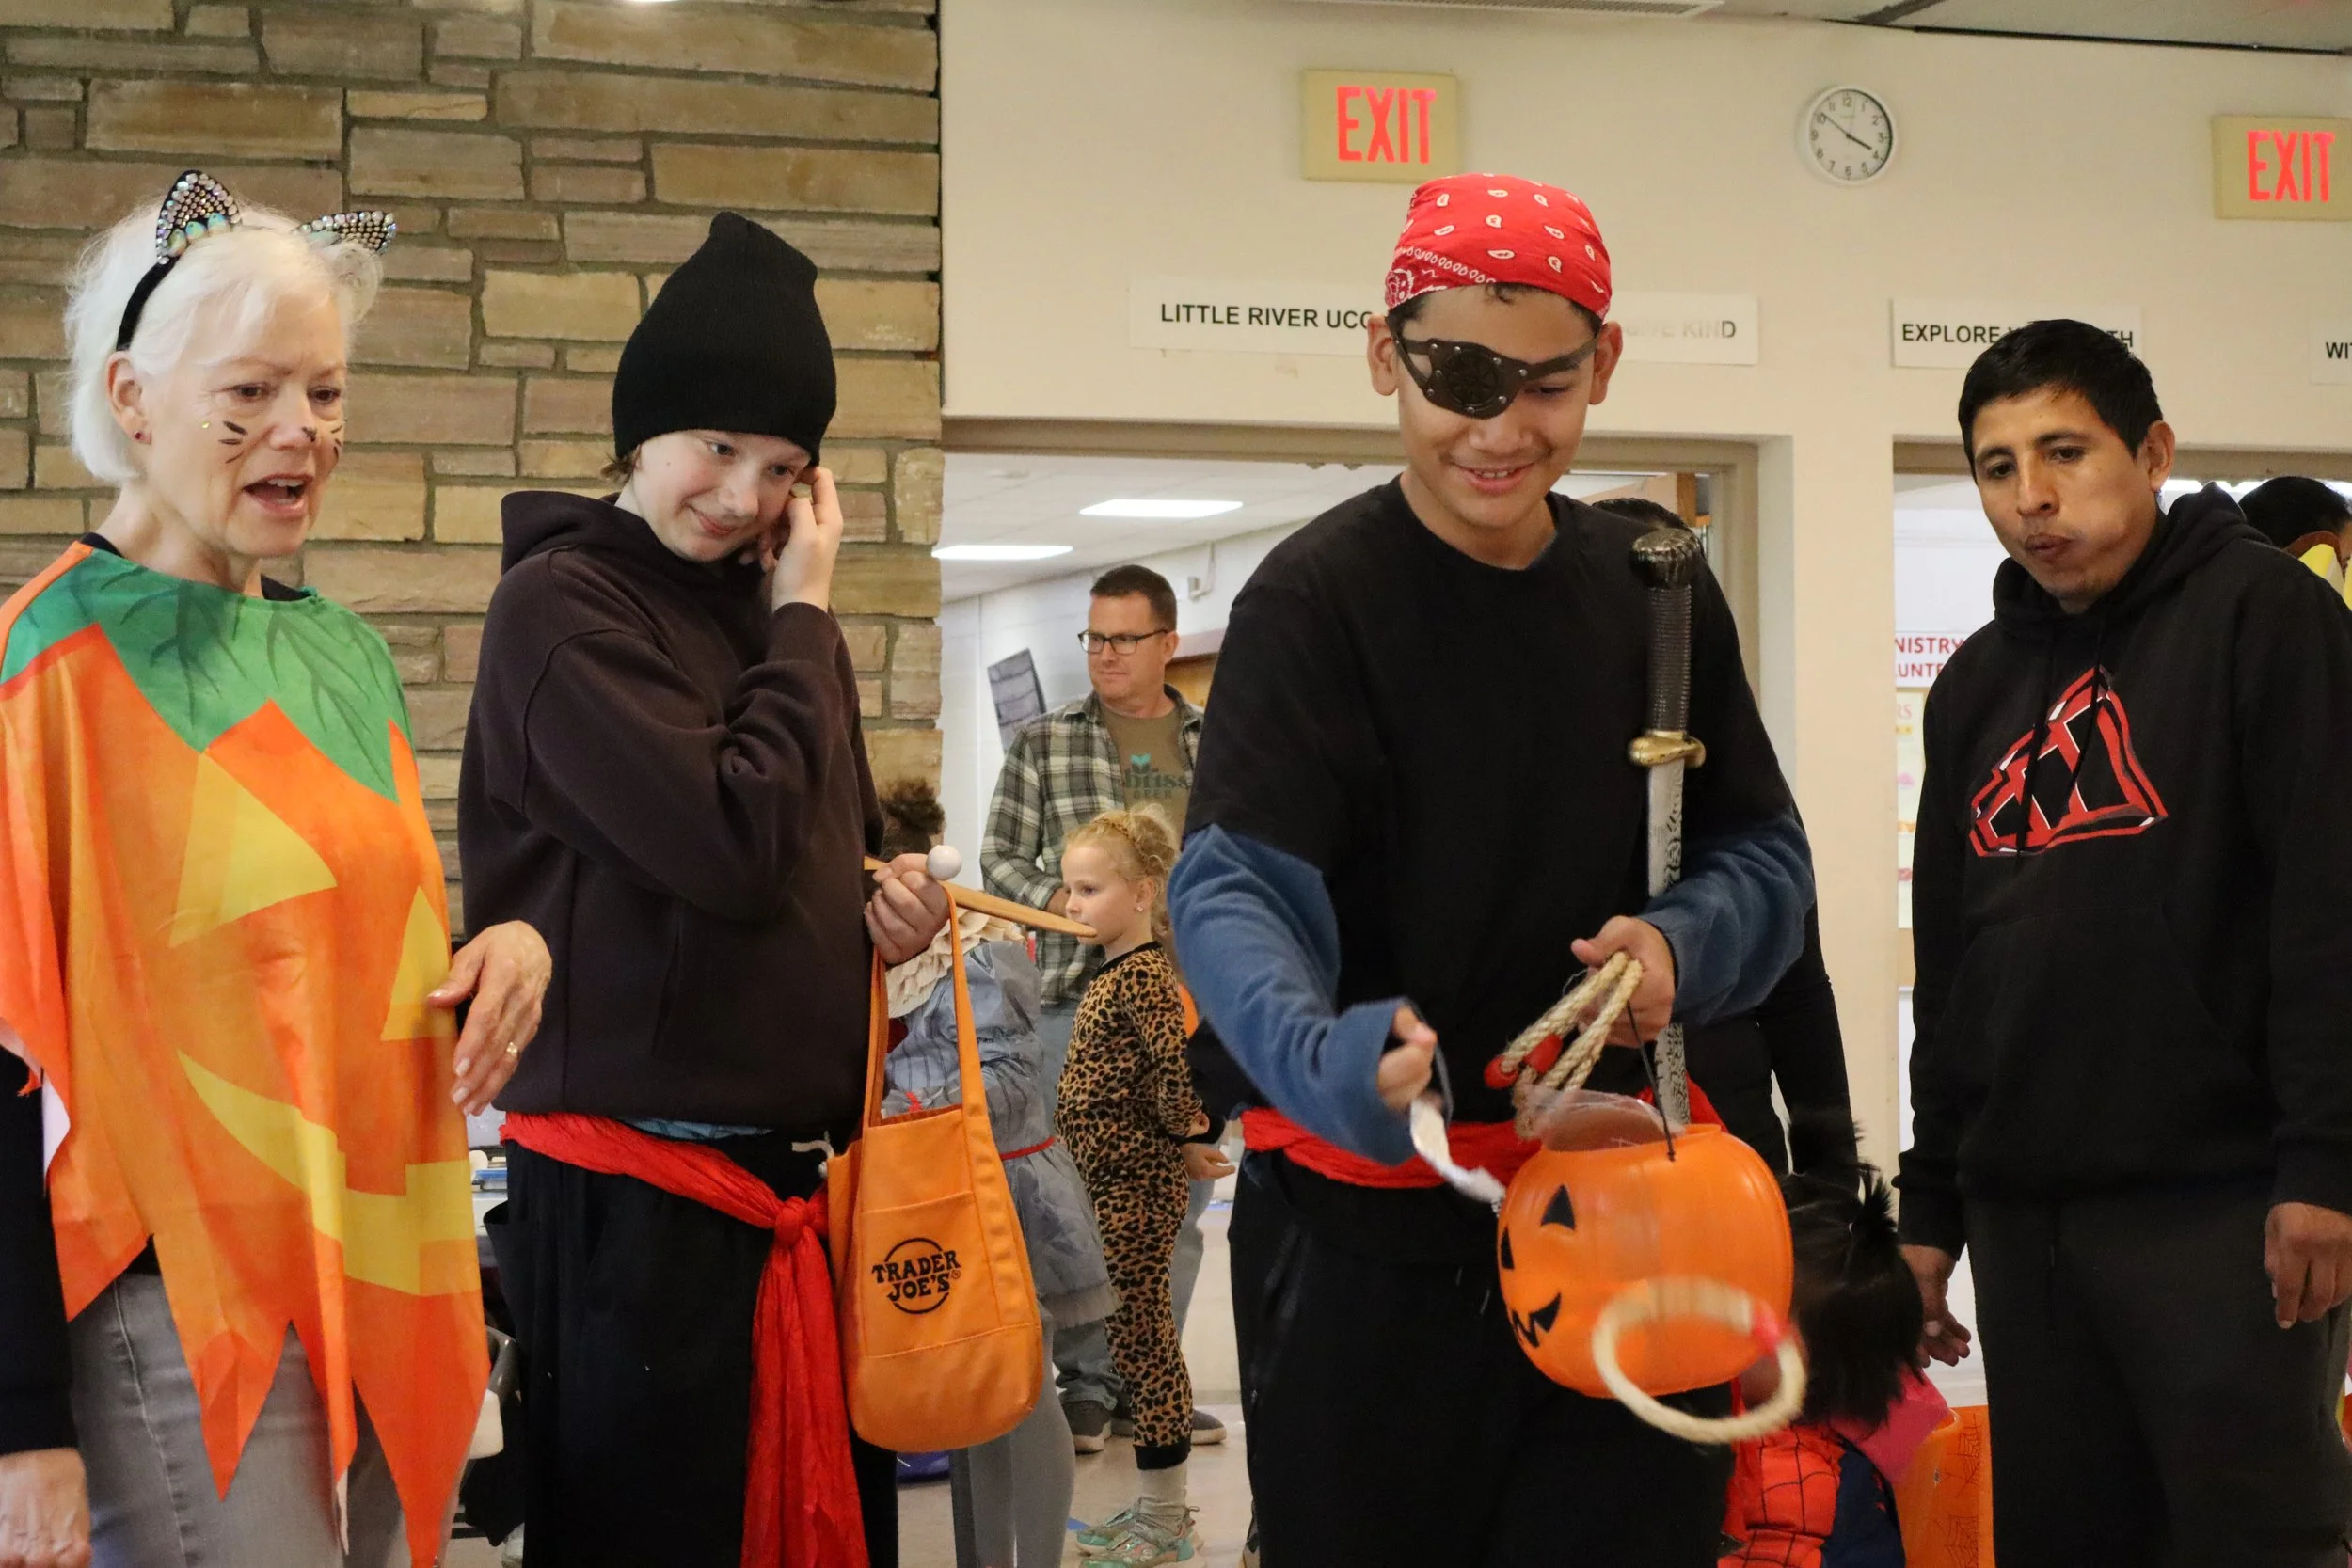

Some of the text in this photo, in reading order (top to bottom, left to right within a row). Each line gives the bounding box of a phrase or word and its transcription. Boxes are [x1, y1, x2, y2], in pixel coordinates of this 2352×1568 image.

[1336, 86, 1437, 164] EXIT
[2246, 130, 2336, 203] EXIT
[1161, 303, 1240, 325] LITTLE
[1248, 307, 1318, 327] RIVER
[1902, 324, 2001, 344] EXPLORE
[2325, 341, 2352, 359] WI
[871, 1250, 961, 1284] TRADER
[886, 1273, 951, 1302] JOE'S
